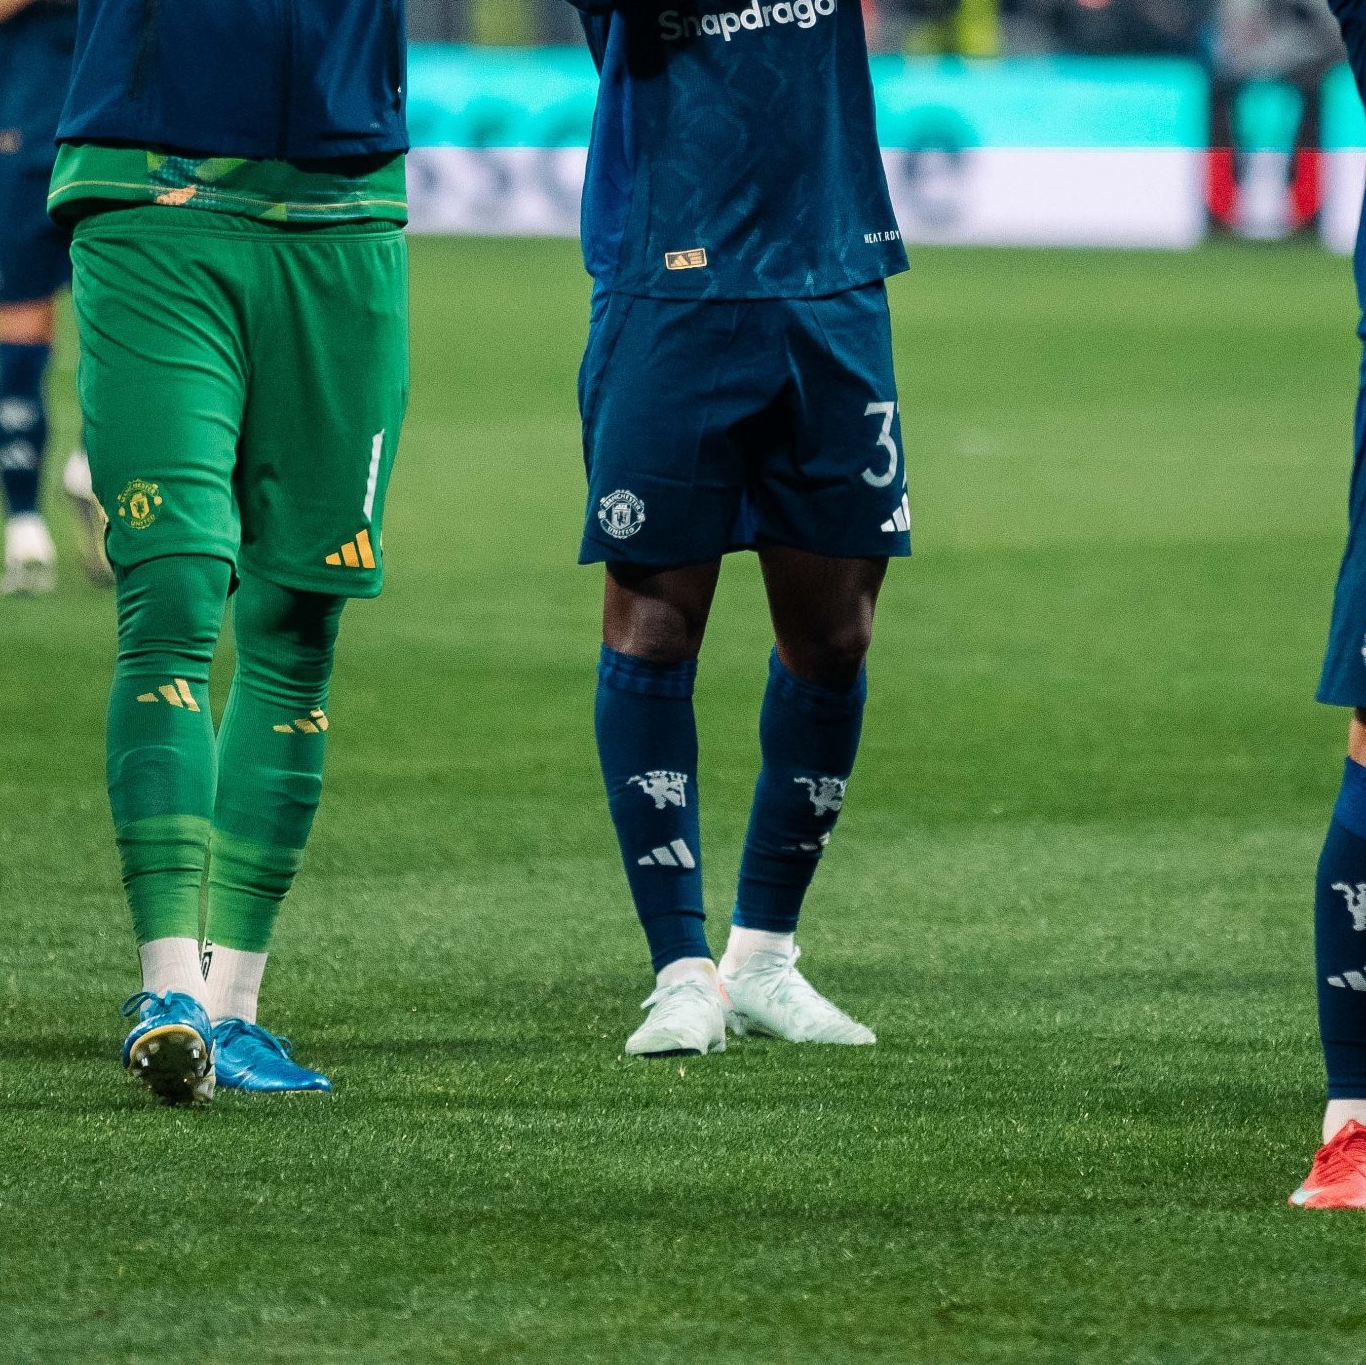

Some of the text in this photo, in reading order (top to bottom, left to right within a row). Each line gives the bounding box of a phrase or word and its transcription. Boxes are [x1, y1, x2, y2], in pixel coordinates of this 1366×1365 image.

[363, 427, 385, 523] 1
[861, 400, 907, 488] 3
[607, 525, 635, 536] UNITED
